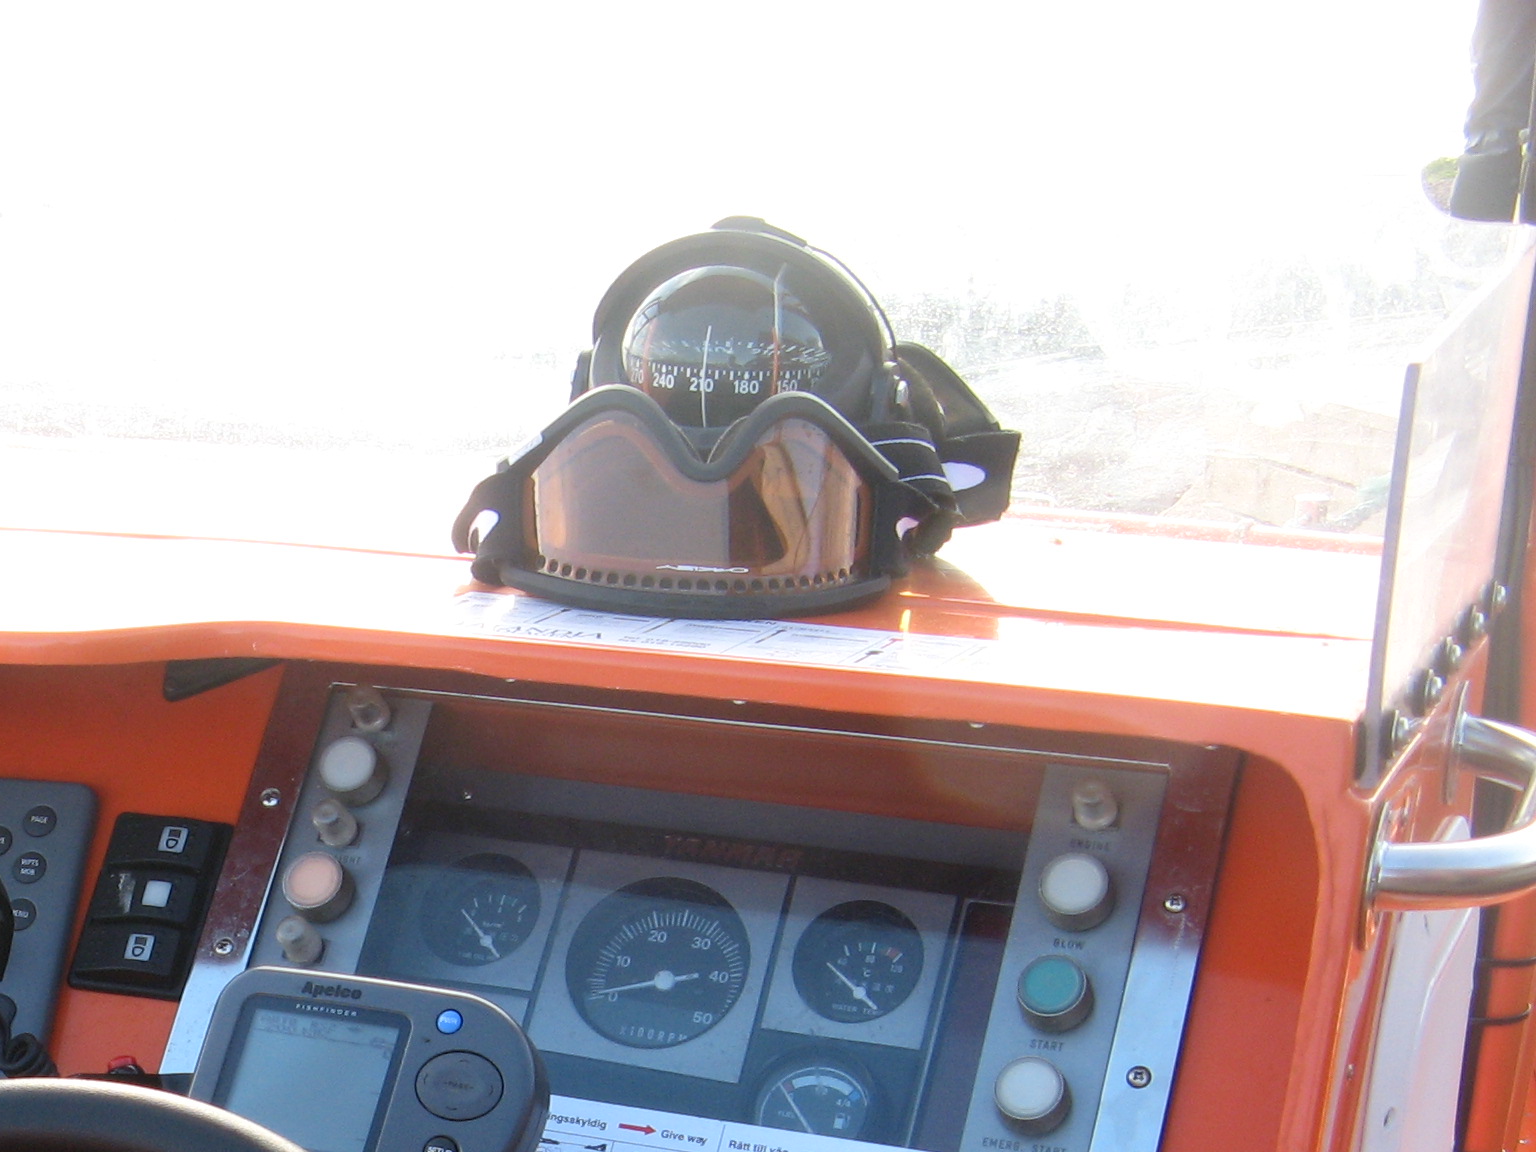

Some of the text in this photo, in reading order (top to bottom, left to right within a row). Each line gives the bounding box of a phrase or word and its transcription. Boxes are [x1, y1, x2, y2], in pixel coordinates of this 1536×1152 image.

[653, 373, 674, 389] 240
[689, 378, 714, 392] 210
[734, 381, 760, 395] 180
[777, 380, 798, 393] 150
[30, 815, 48, 824] PAGE
[648, 930, 667, 943] 20
[691, 936, 711, 950] 30
[616, 955, 631, 968] 10
[709, 971, 729, 984] 40
[301, 981, 363, 1000] Apelco
[608, 992, 618, 1002] 0
[295, 1003, 358, 1017] FISHFINDER
[832, 1003, 858, 1012] WATER
[693, 1011, 713, 1025] 50
[1029, 1039, 1064, 1052] START
[547, 1112, 608, 1131] ingsskyldig
[661, 1129, 708, 1146] Give way
[982, 1137, 1023, 1151] EMERG.
[728, 1139, 750, 1151] Rätt
[753, 1142, 767, 1152] till
